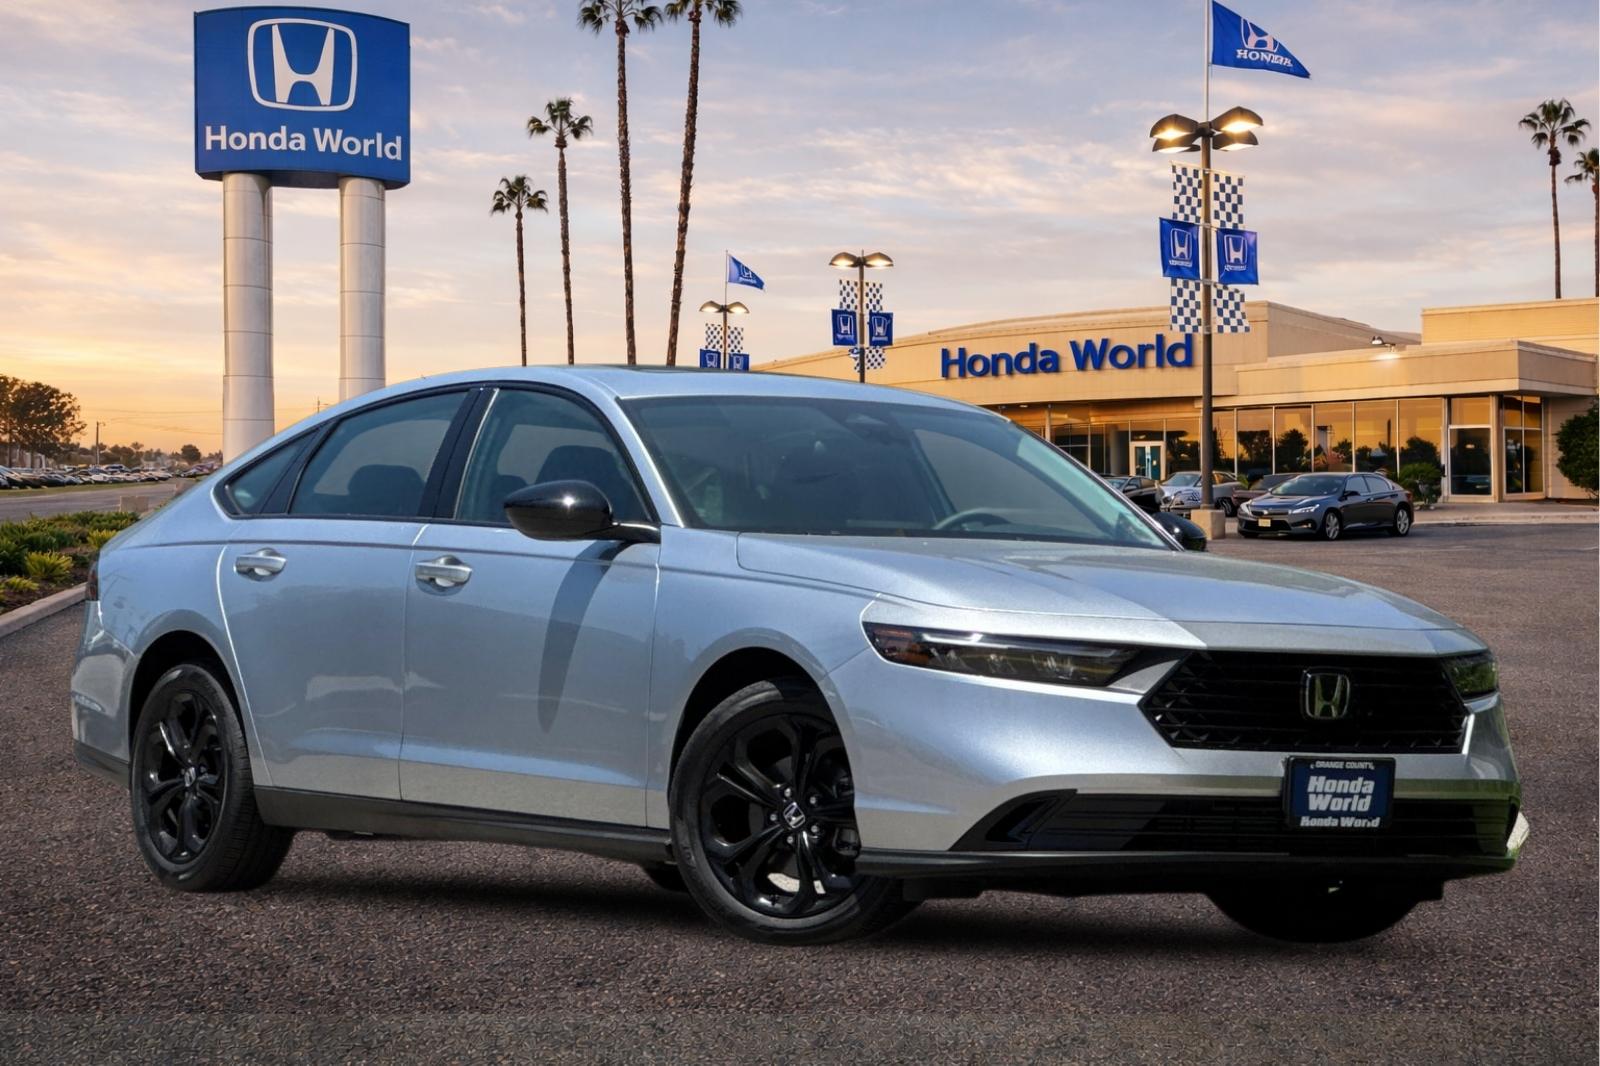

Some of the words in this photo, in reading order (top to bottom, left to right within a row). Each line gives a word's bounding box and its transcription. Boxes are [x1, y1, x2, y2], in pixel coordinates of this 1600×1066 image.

[205, 125, 306, 151] Honda
[313, 127, 402, 161] World
[941, 342, 1061, 379] Honda
[1069, 333, 1195, 372] World
[1307, 775, 1375, 794] Honda
[1308, 793, 1372, 812] World
[1300, 815, 1339, 827] Honda
